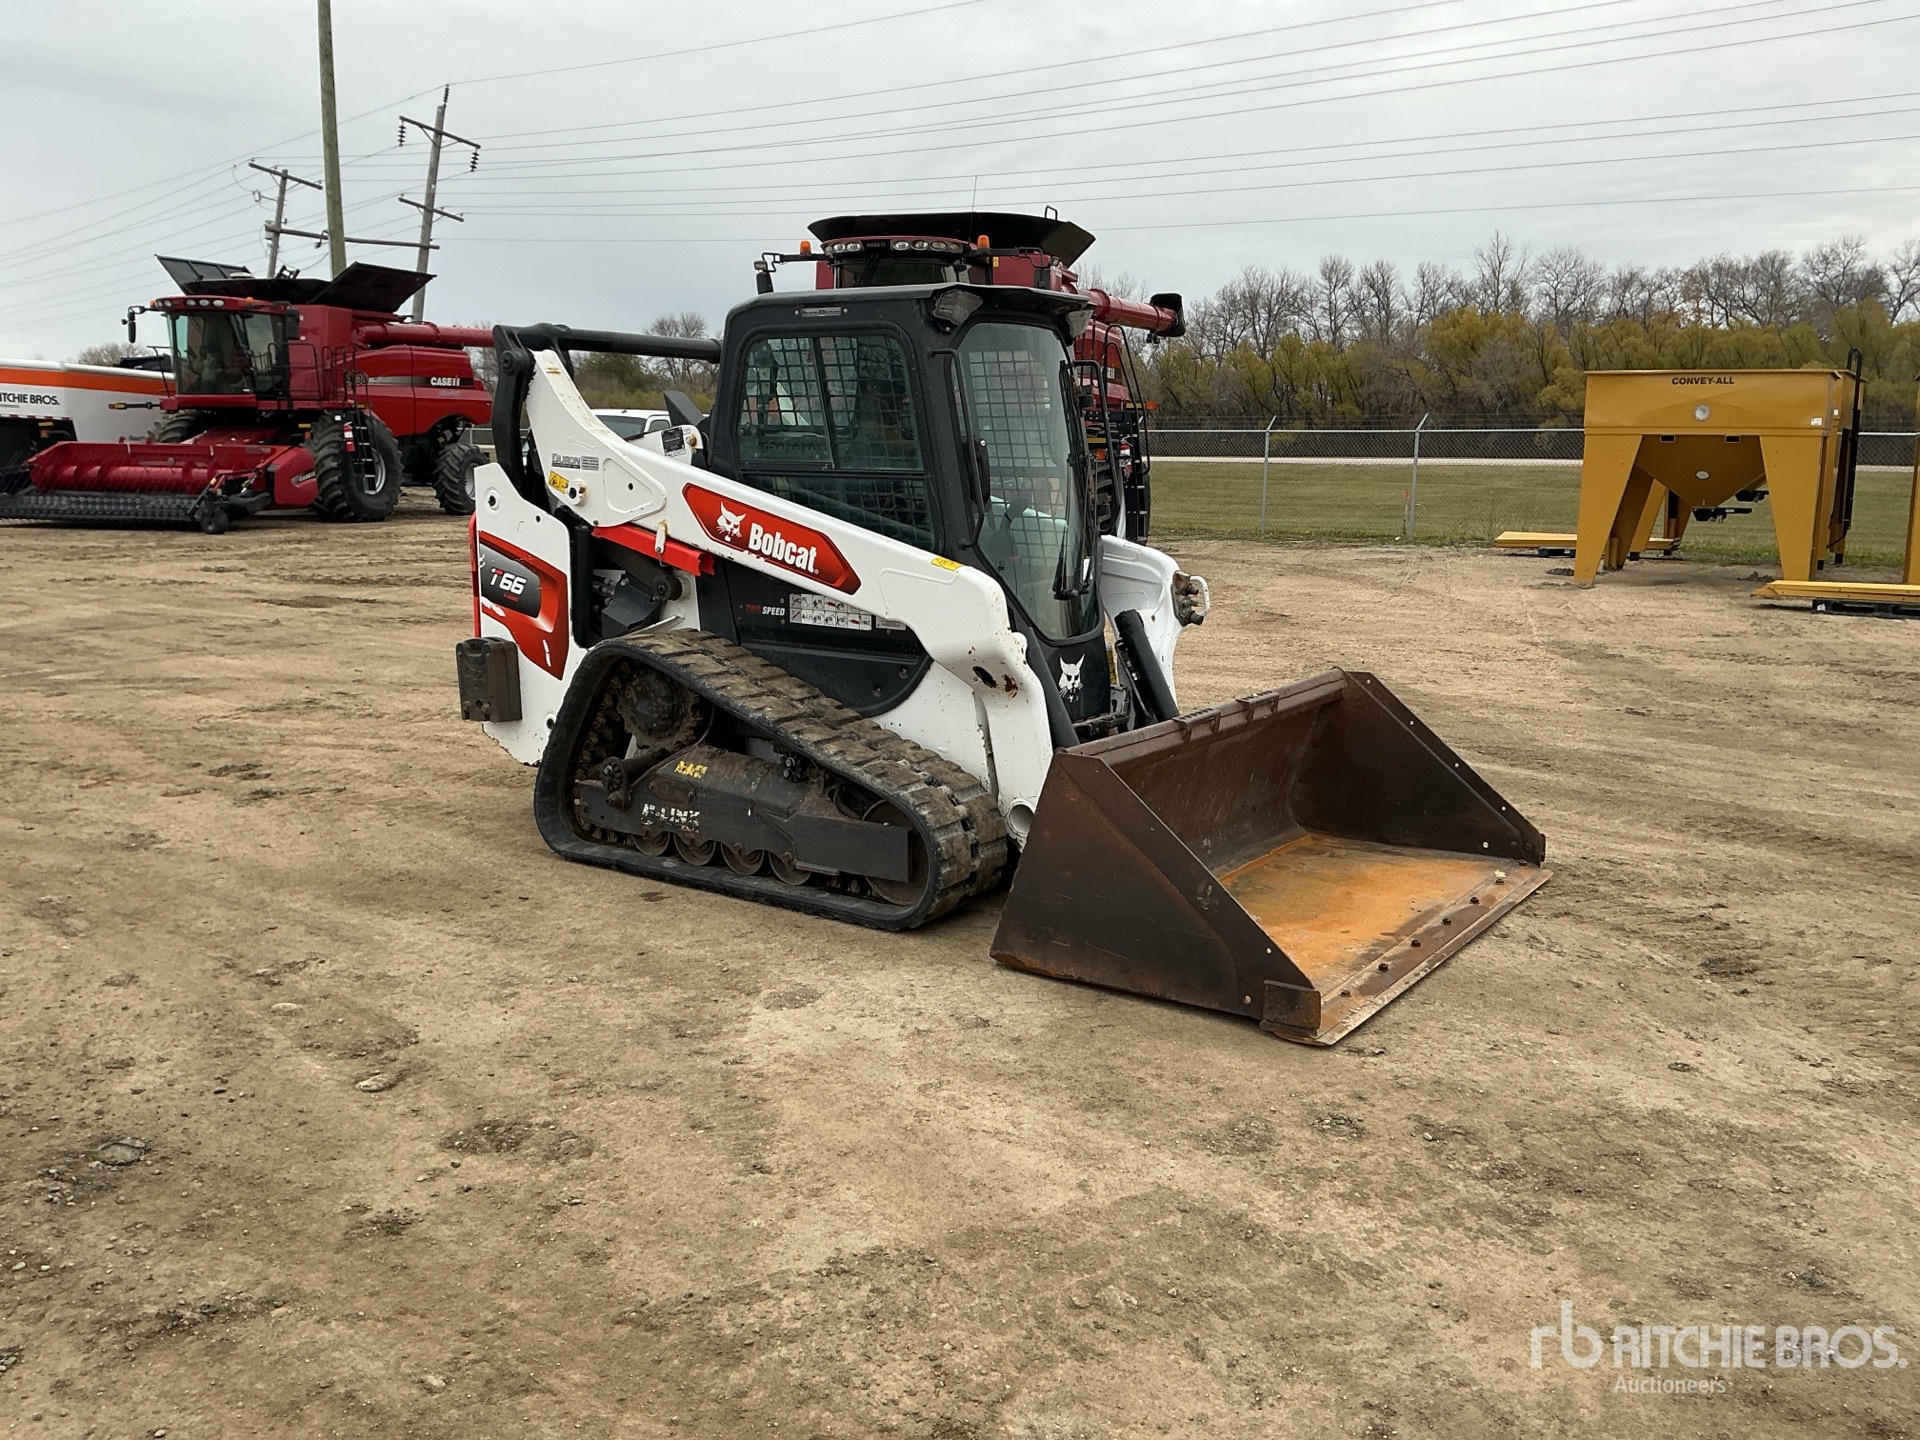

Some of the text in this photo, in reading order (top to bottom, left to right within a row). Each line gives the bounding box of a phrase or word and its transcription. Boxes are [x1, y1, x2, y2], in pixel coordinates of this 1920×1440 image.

[1672, 376, 1735, 386] CONVEY-ALL
[0, 392, 60, 406] ITCHIE BROS.
[748, 522, 818, 574] Bobcat
[490, 567, 528, 595] T66
[761, 605, 786, 616] SPEED
